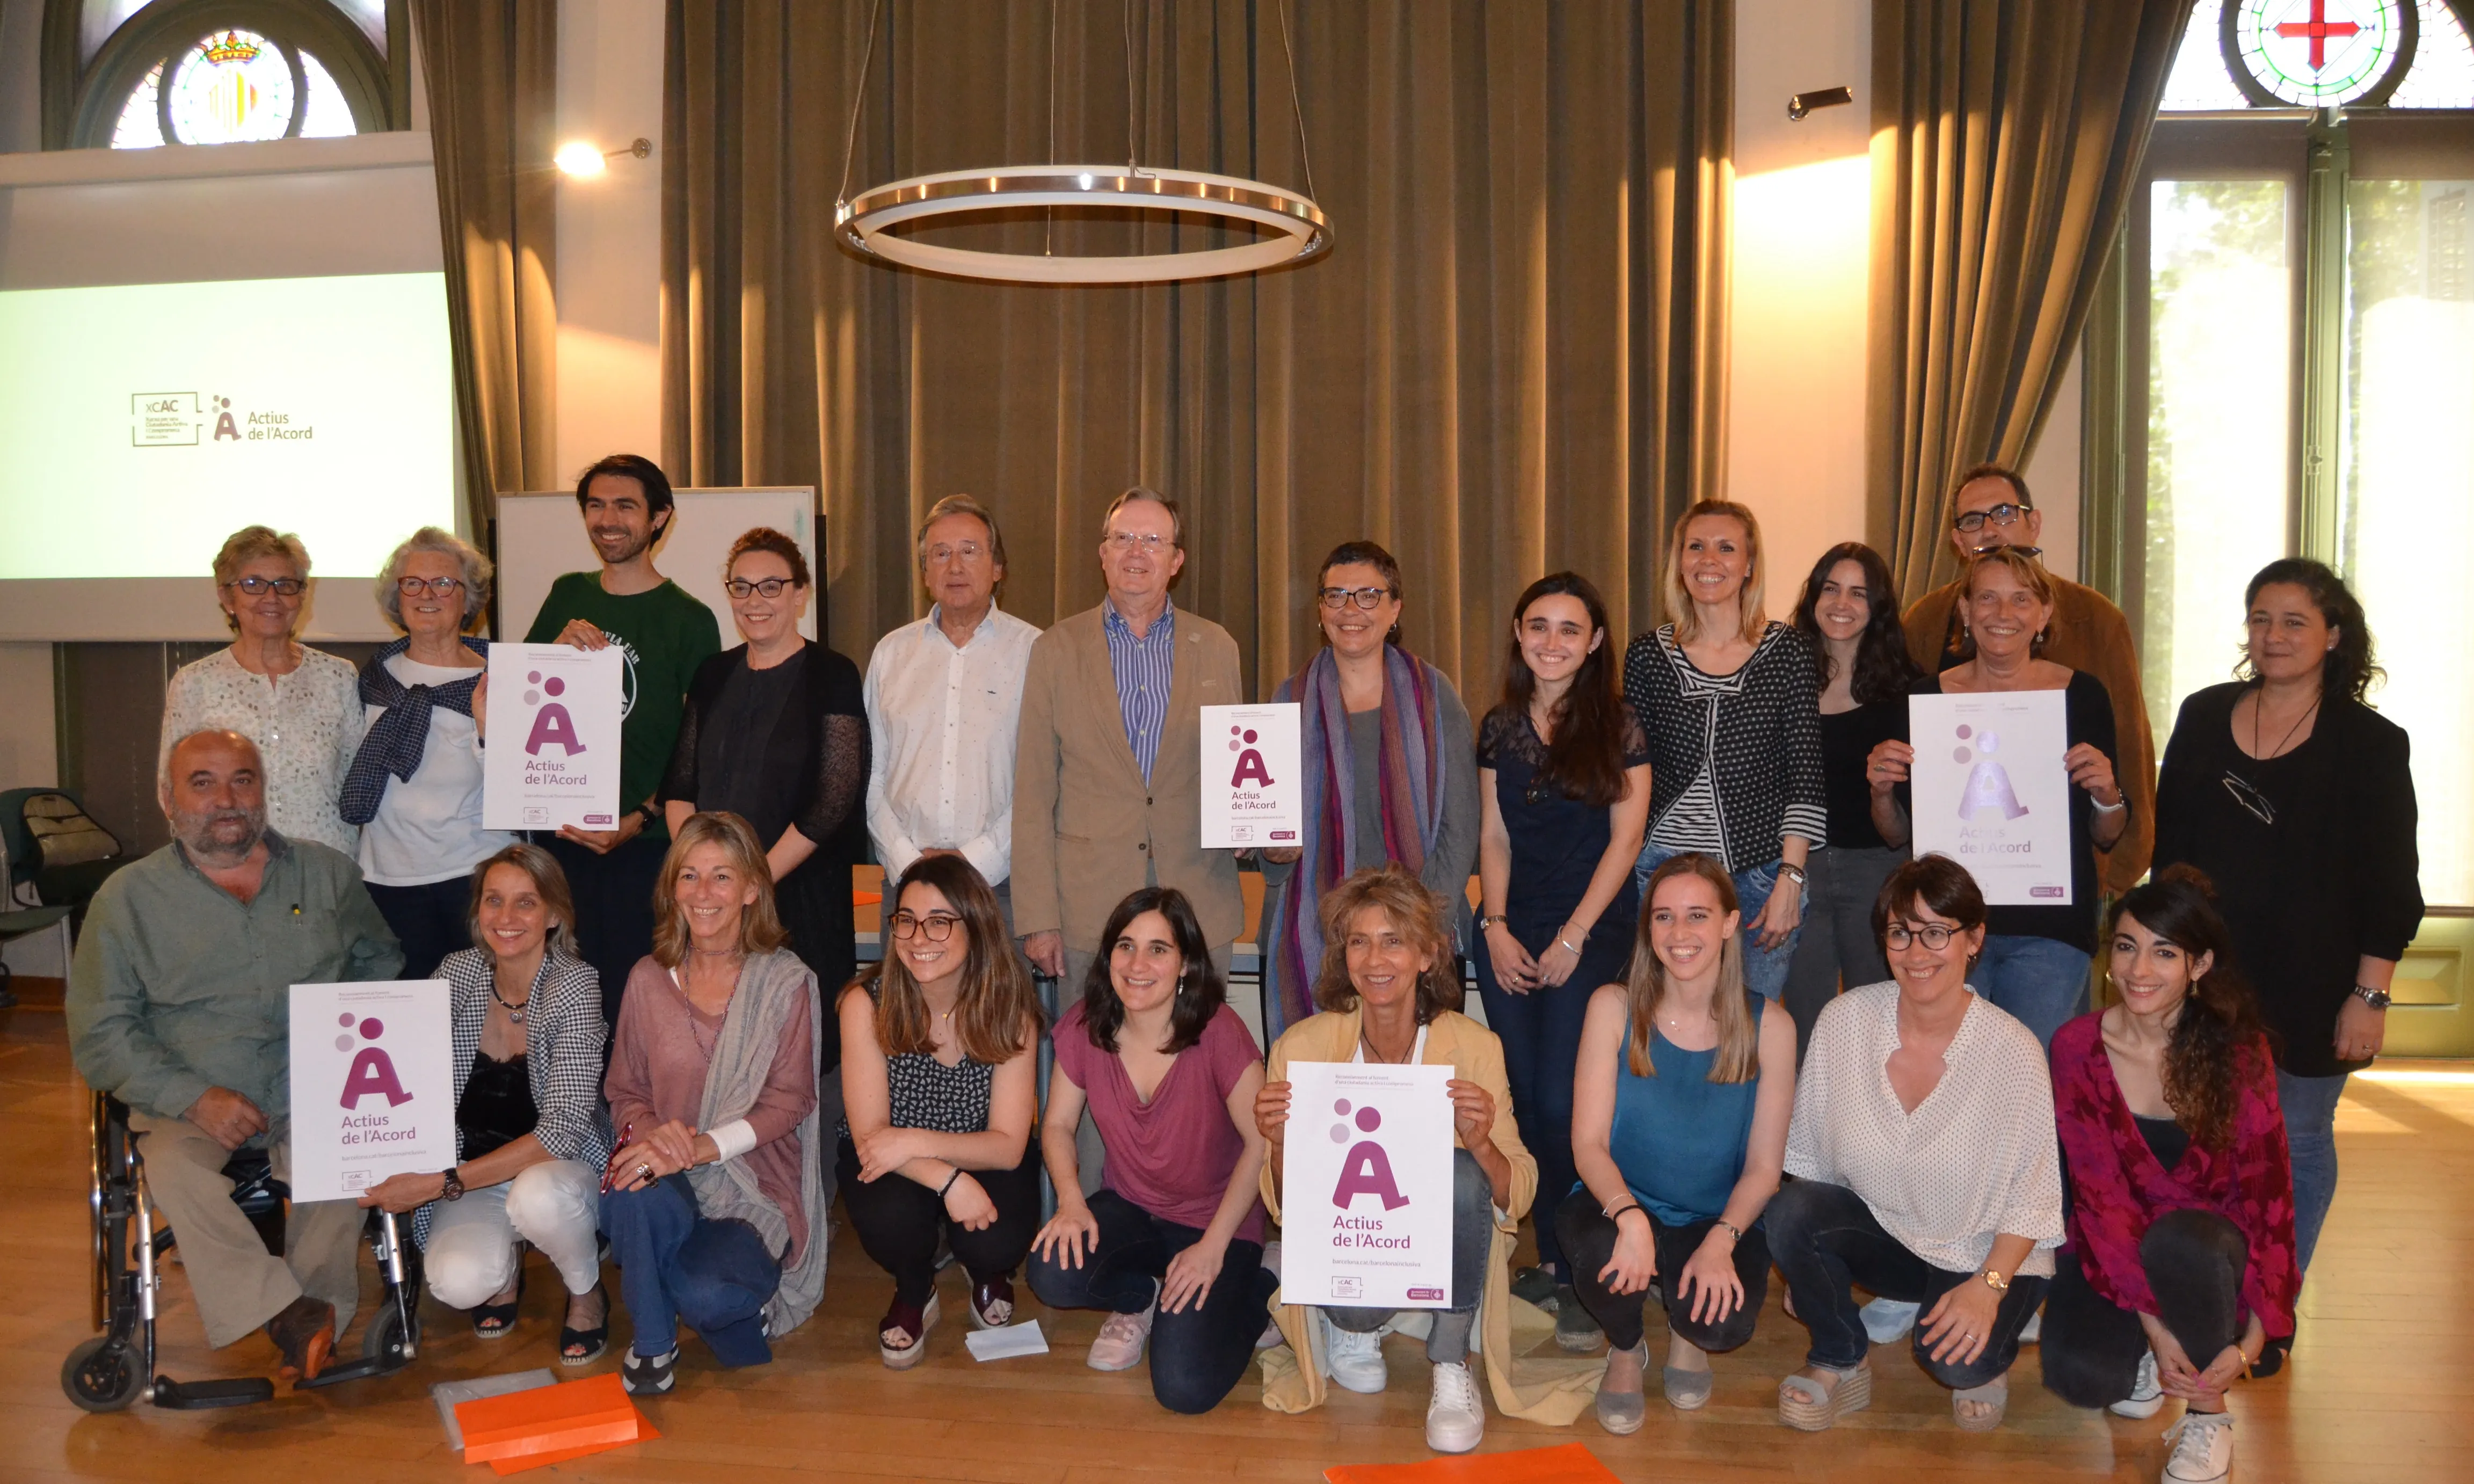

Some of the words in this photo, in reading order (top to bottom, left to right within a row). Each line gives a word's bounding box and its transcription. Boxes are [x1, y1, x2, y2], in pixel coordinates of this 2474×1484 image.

[248, 411, 289, 424] Actius
[249, 427, 264, 440] de
[267, 426, 312, 440] l'Acord
[525, 760, 565, 772] Actius
[525, 774, 540, 784] de
[543, 774, 587, 785] l'Acord
[1232, 791, 1260, 800] Actius
[1232, 801, 1243, 810] de
[1245, 801, 1276, 810] l'Acord
[1960, 841, 1978, 854] de
[1981, 840, 2031, 853] lAcord
[341, 1114, 389, 1129] Actius
[341, 1132, 360, 1145] de
[365, 1126, 416, 1143] l'Acord
[1333, 1215, 1383, 1231] Actius
[1333, 1233, 1351, 1247] de
[1356, 1233, 1410, 1249] l'Acord
[1332, 1259, 1421, 1268] barcelona.cat/barcelonainclusiva
